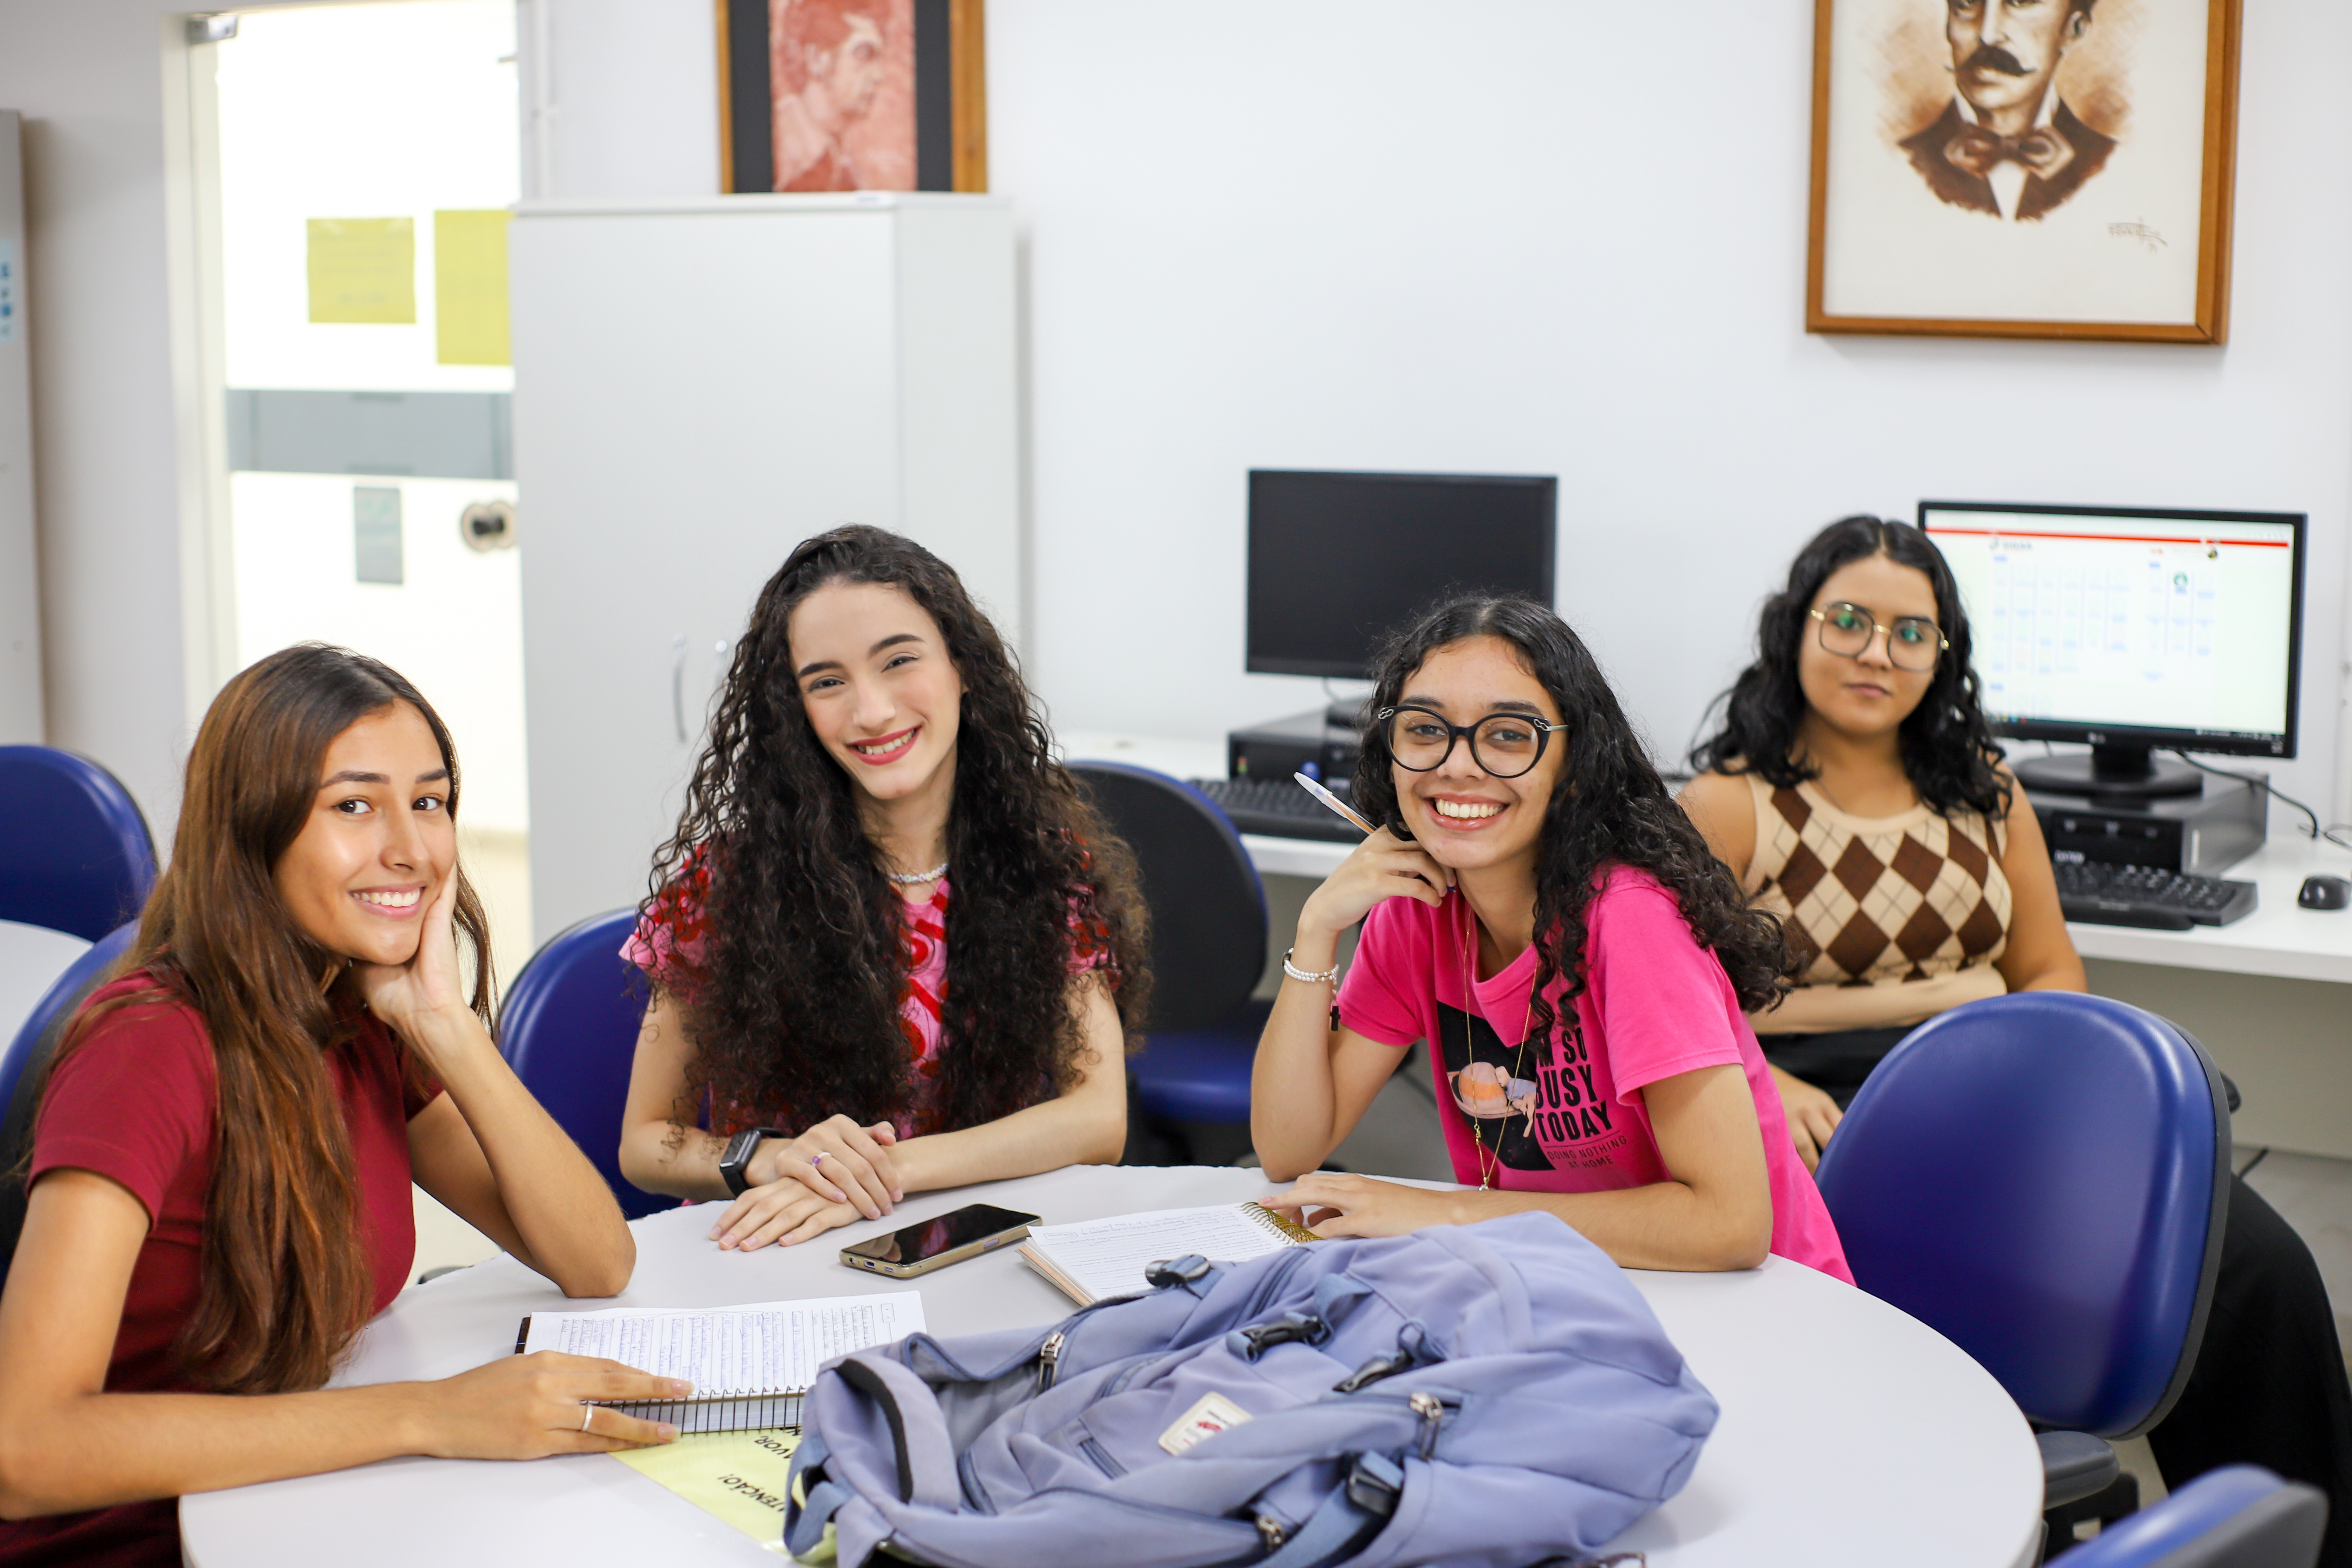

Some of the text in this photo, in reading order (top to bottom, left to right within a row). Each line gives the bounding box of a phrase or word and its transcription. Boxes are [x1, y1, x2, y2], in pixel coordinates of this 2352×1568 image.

[1561, 1027, 1587, 1064] SO
[1536, 1100, 1612, 1142] TODAY
[1547, 1135, 1627, 1160] DOING NOTHING
[1583, 1155, 1614, 1169] HOME
